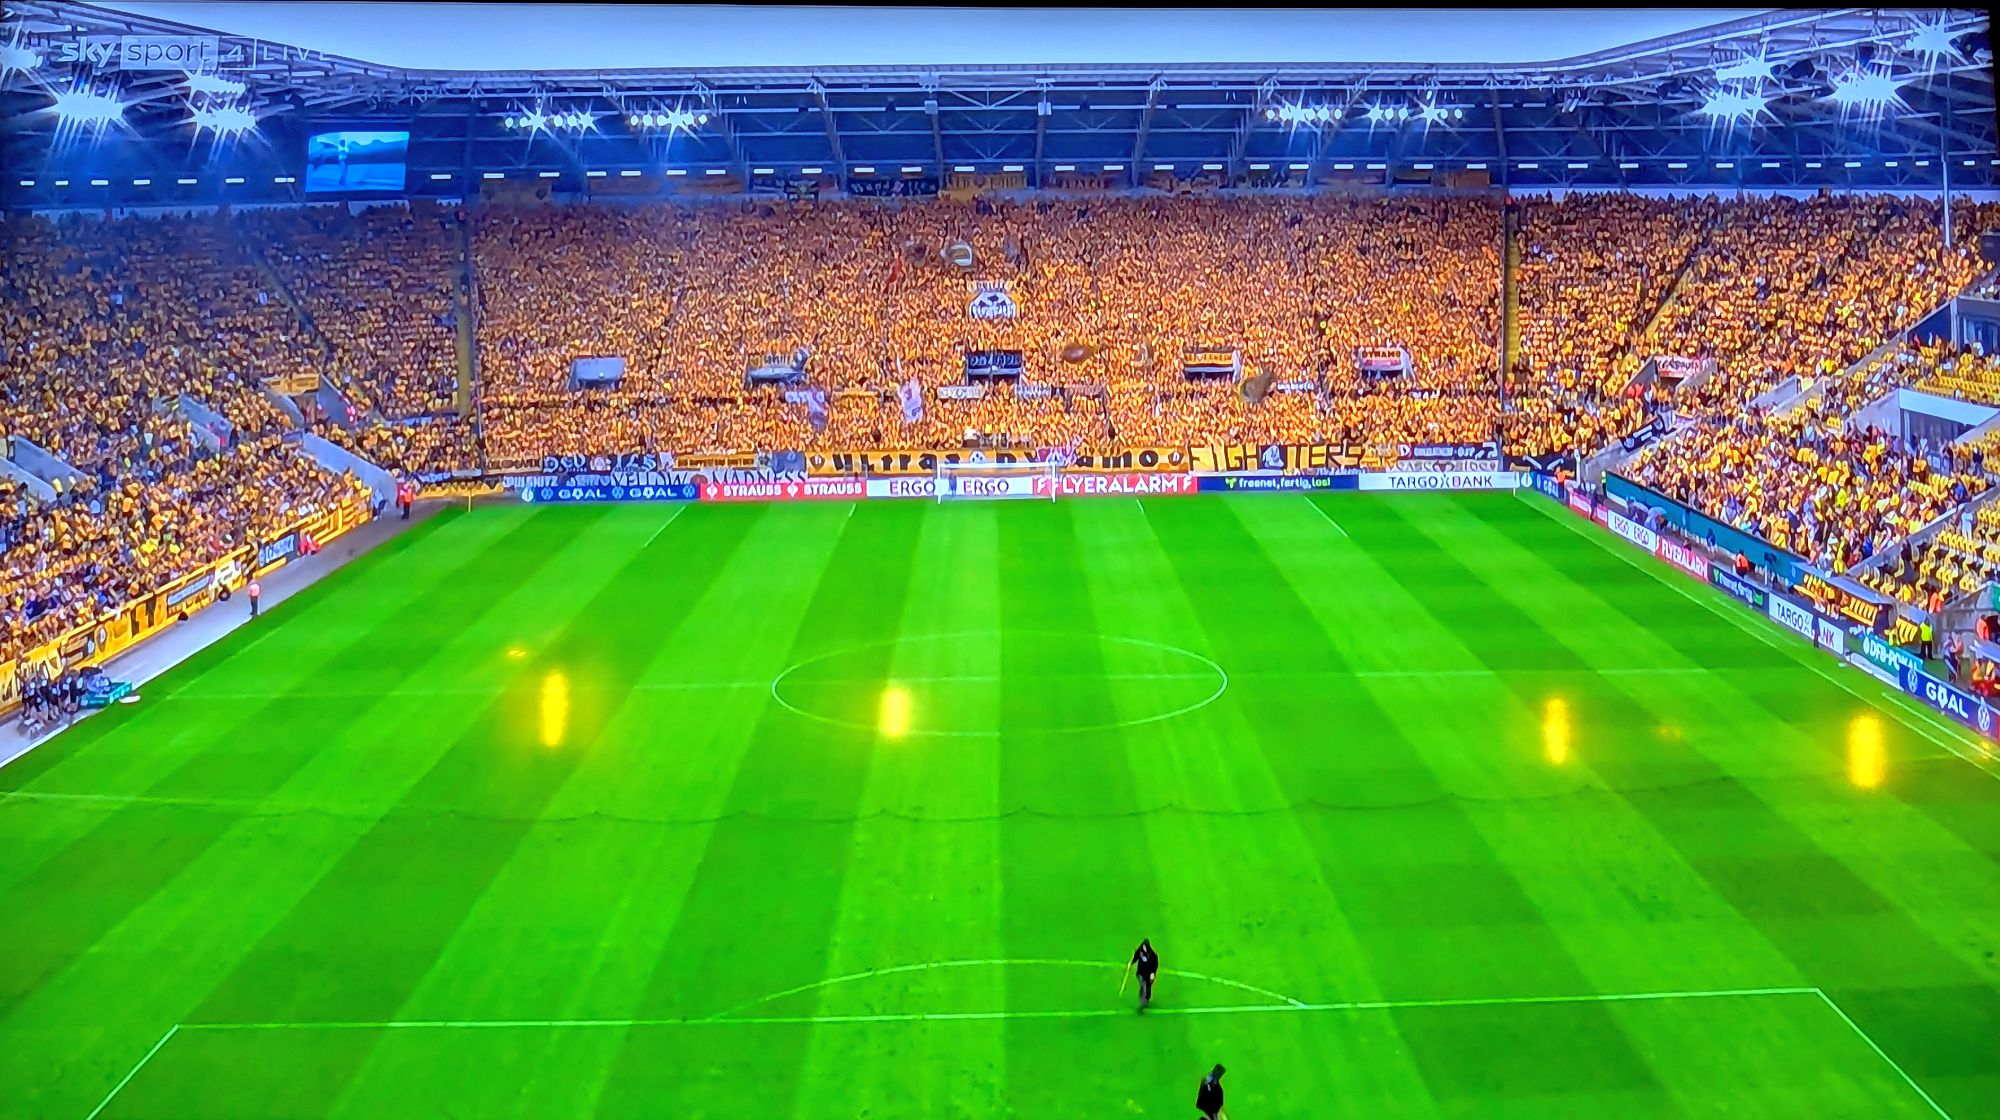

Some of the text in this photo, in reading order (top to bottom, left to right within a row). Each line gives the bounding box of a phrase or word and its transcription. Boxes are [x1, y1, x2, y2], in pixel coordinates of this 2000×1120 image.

[558, 487, 678, 500] GOAL GOAL
[723, 480, 862, 497] STRAUSS STRAUSS
[889, 478, 1009, 496] ERGO ERGO
[1926, 681, 1969, 719] GOAL
